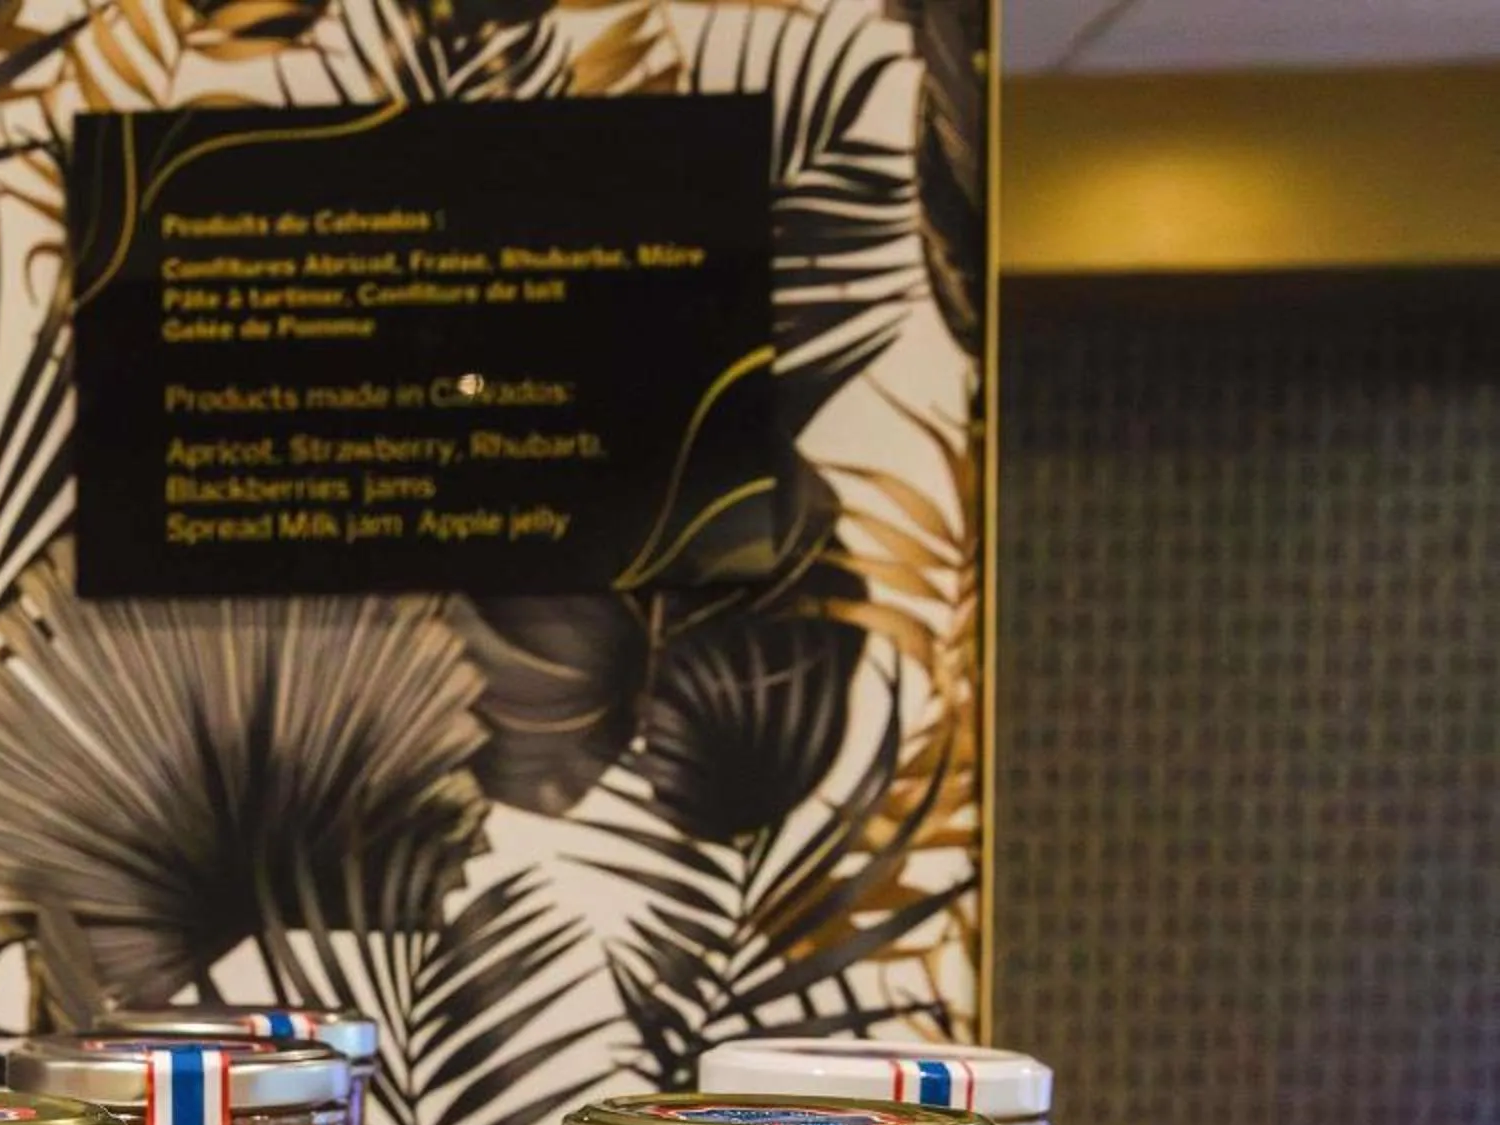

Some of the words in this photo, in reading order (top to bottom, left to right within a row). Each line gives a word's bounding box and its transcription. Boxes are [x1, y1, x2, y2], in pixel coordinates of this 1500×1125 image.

[163, 213, 269, 238] Produits
[314, 209, 430, 233] Calvados
[162, 256, 296, 281] Confitures
[357, 281, 479, 306] Confiture
[165, 384, 299, 413] Products
[306, 382, 389, 410] made
[399, 383, 426, 408] in
[166, 475, 350, 503] Blackberries
[363, 474, 437, 503] jams
[166, 512, 273, 543] Spread
[279, 511, 338, 539] Milk
[347, 511, 404, 541] jam
[417, 511, 502, 539] Apple
[509, 506, 572, 540] jelly
